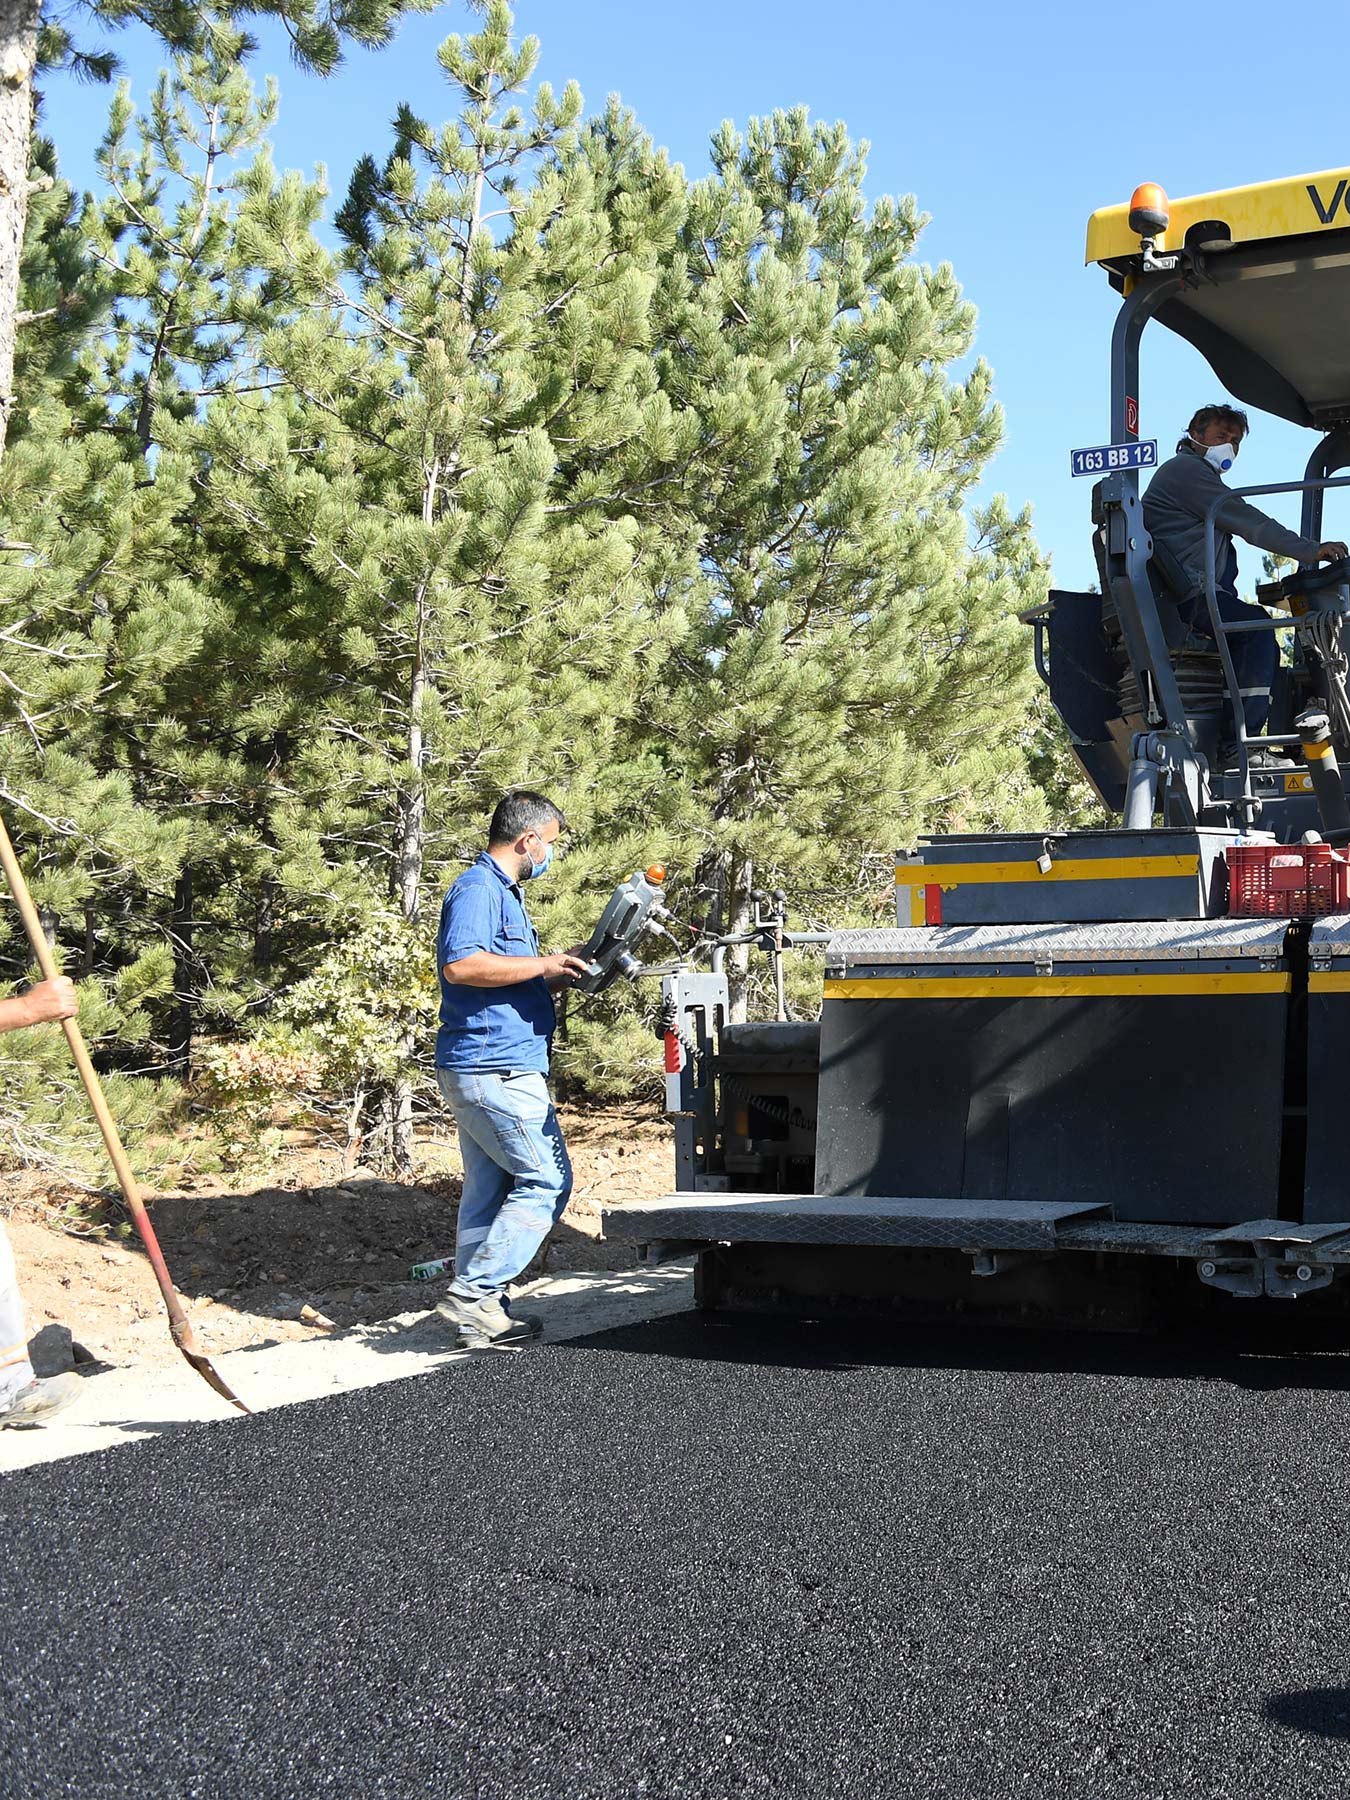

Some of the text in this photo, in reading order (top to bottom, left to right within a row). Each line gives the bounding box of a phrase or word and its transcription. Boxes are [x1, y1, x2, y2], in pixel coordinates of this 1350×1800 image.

[1077, 445, 1153, 471] 163 BB 12
